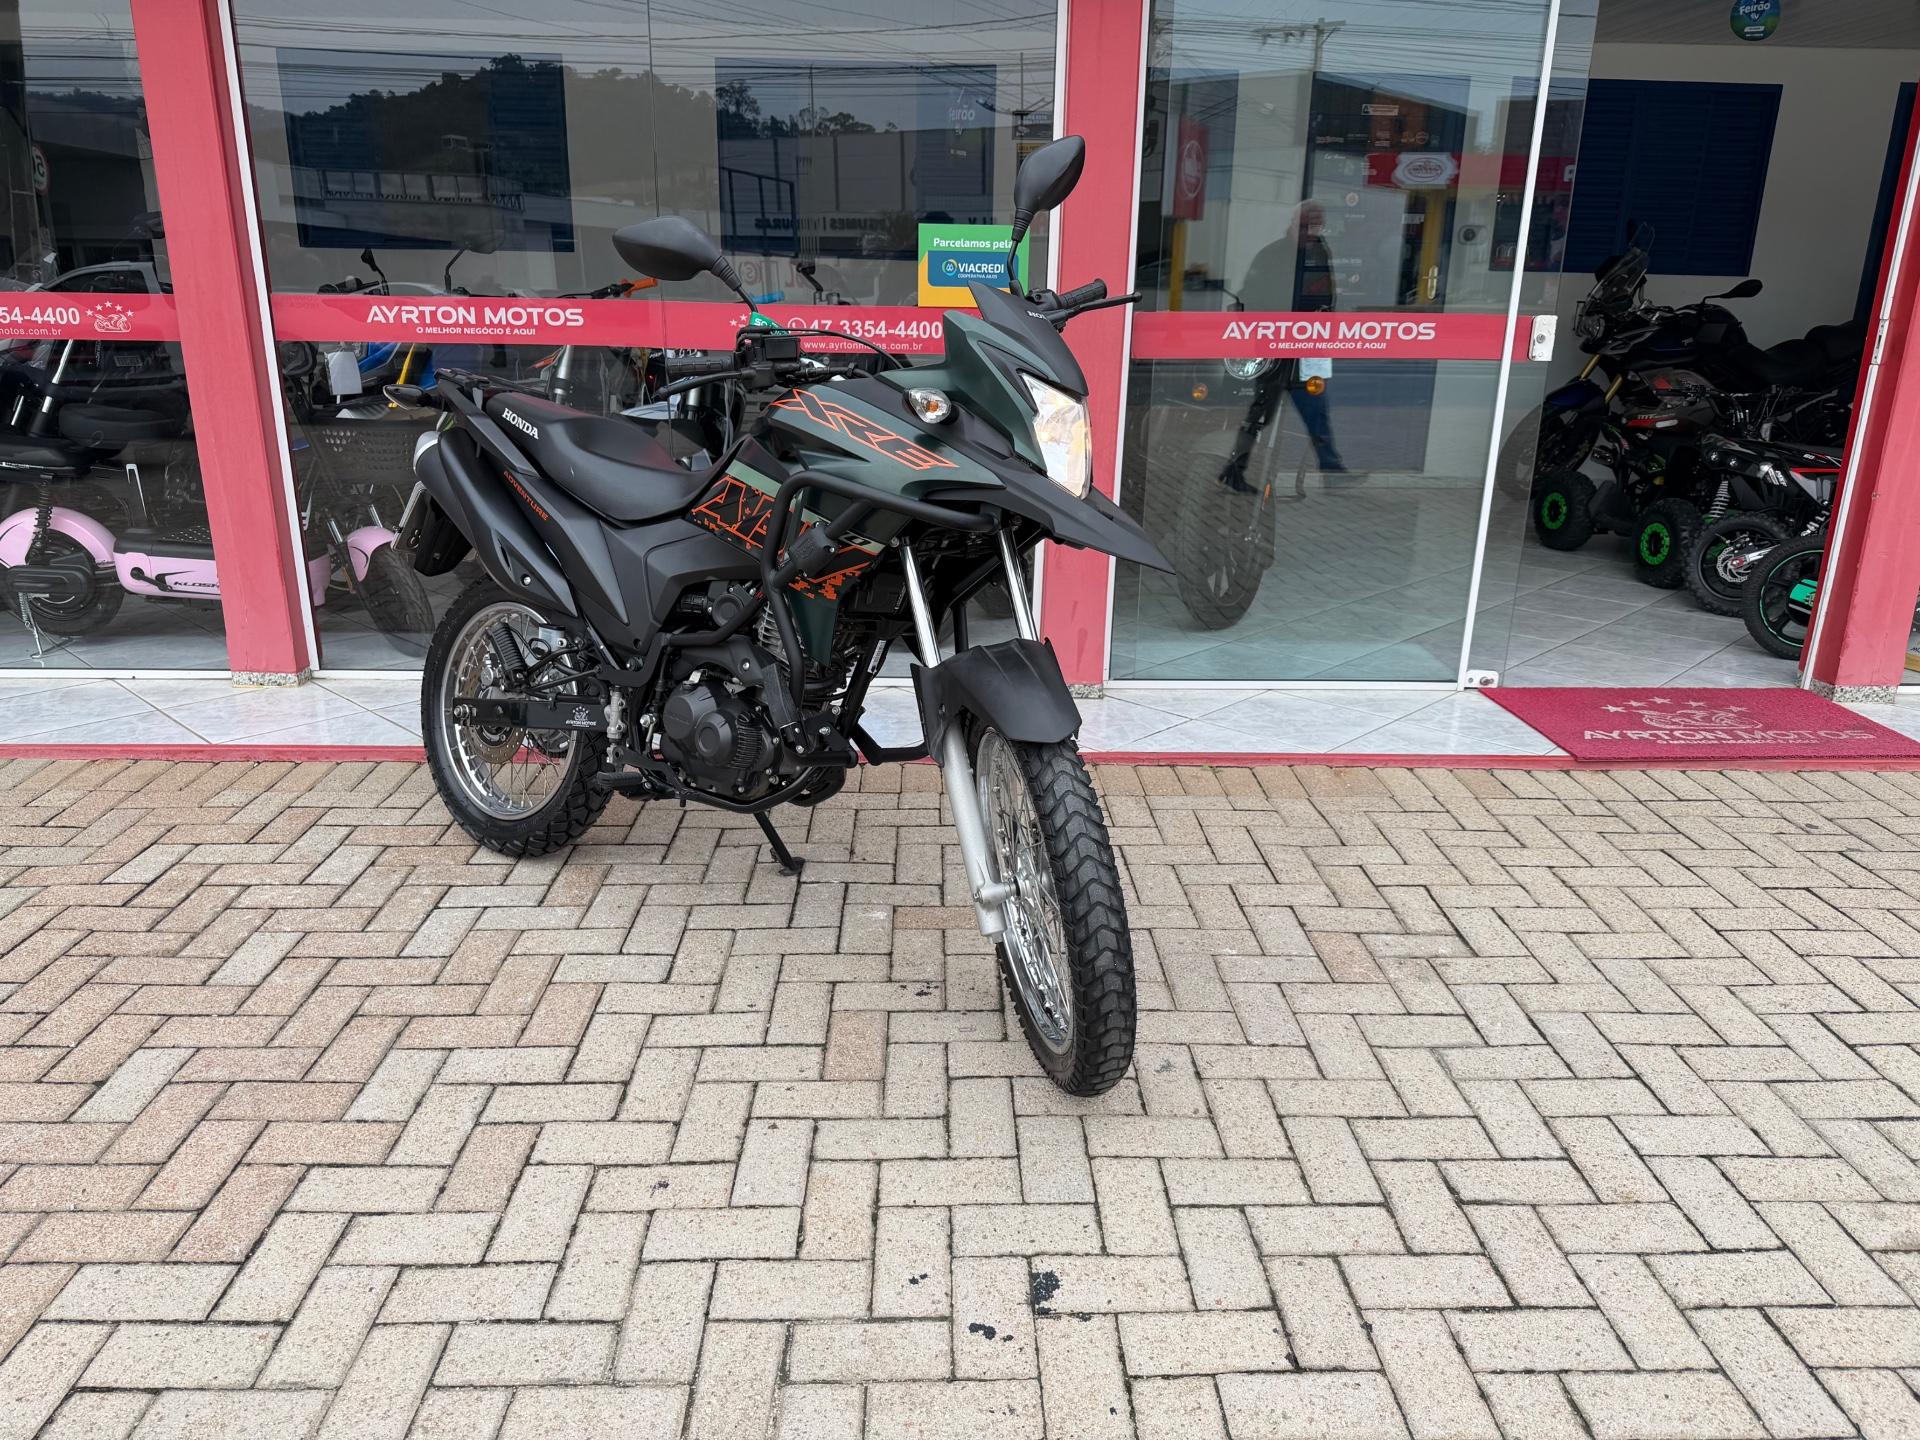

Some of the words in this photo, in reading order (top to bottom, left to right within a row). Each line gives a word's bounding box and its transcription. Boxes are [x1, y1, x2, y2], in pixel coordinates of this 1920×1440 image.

[933, 237, 991, 249] Parcelamos
[958, 263, 1004, 274] VIACREDI
[367, 305, 476, 325] AYRTON
[484, 306, 585, 327] MOTOS
[416, 326, 424, 334] O
[425, 327, 462, 335] MELHOR
[463, 326, 504, 335] NEGÓCIO
[505, 326, 512, 335] É
[513, 327, 536, 336] AQUI
[840, 319, 942, 339] 3354-4400
[1222, 321, 1331, 340] AYRTON
[1338, 321, 1437, 340] MOTOS
[1277, 342, 1314, 350] MELHOR
[1315, 341, 1355, 350] NEGÓCIO
[1356, 340, 1363, 350] É
[1363, 342, 1387, 350] AQUI
[502, 407, 540, 440] HONDA
[503, 470, 550, 521] ADVENTURE
[1584, 730, 1733, 740] AYRTON
[1734, 730, 1877, 740] MOTOS
